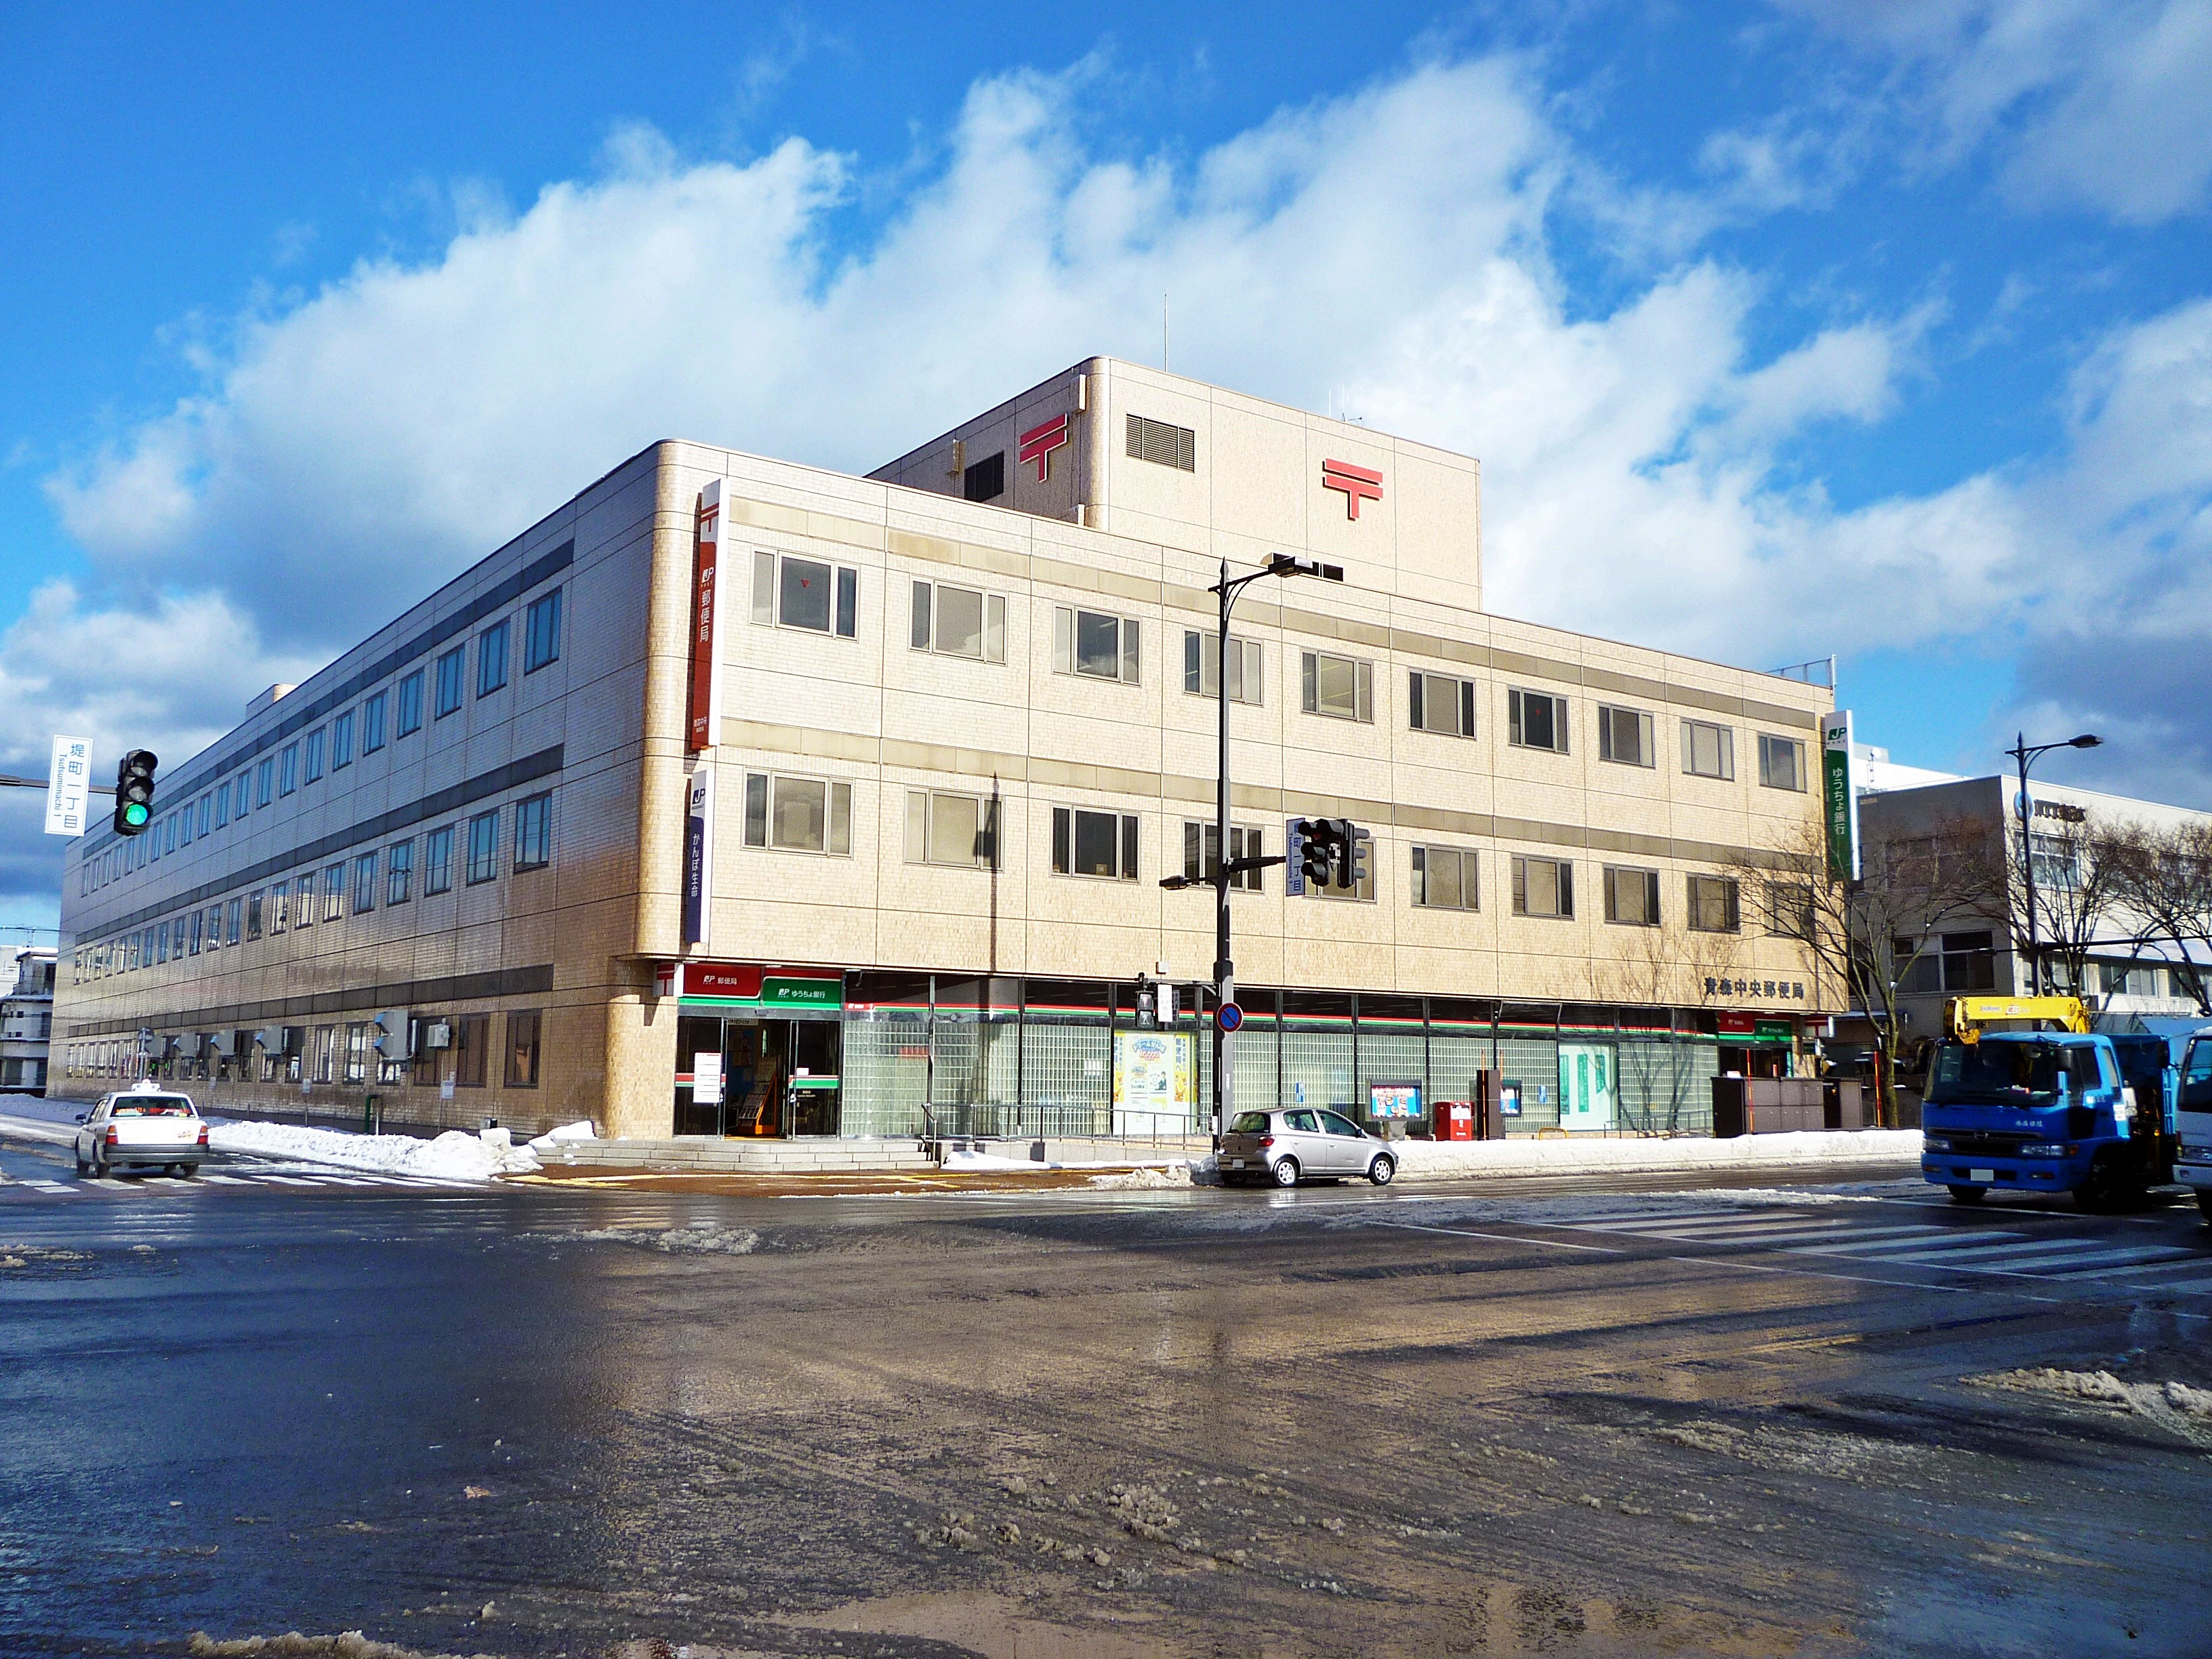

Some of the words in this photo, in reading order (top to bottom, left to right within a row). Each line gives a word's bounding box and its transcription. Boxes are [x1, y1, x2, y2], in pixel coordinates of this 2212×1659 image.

[700, 589, 711, 643] 郵便局
[1828, 726, 1847, 740] JP
[54, 753, 67, 811] Tsutsumimachi
[64, 743, 85, 829] 堤町一丁目
[692, 787, 705, 805] JP
[1832, 767, 1846, 835] ゆうちょ銀行
[691, 833, 701, 897] かんぽ生命
[792, 989, 826, 999] ゆうちょ銀行
[1704, 977, 1805, 1000] 青森中央郵便局
